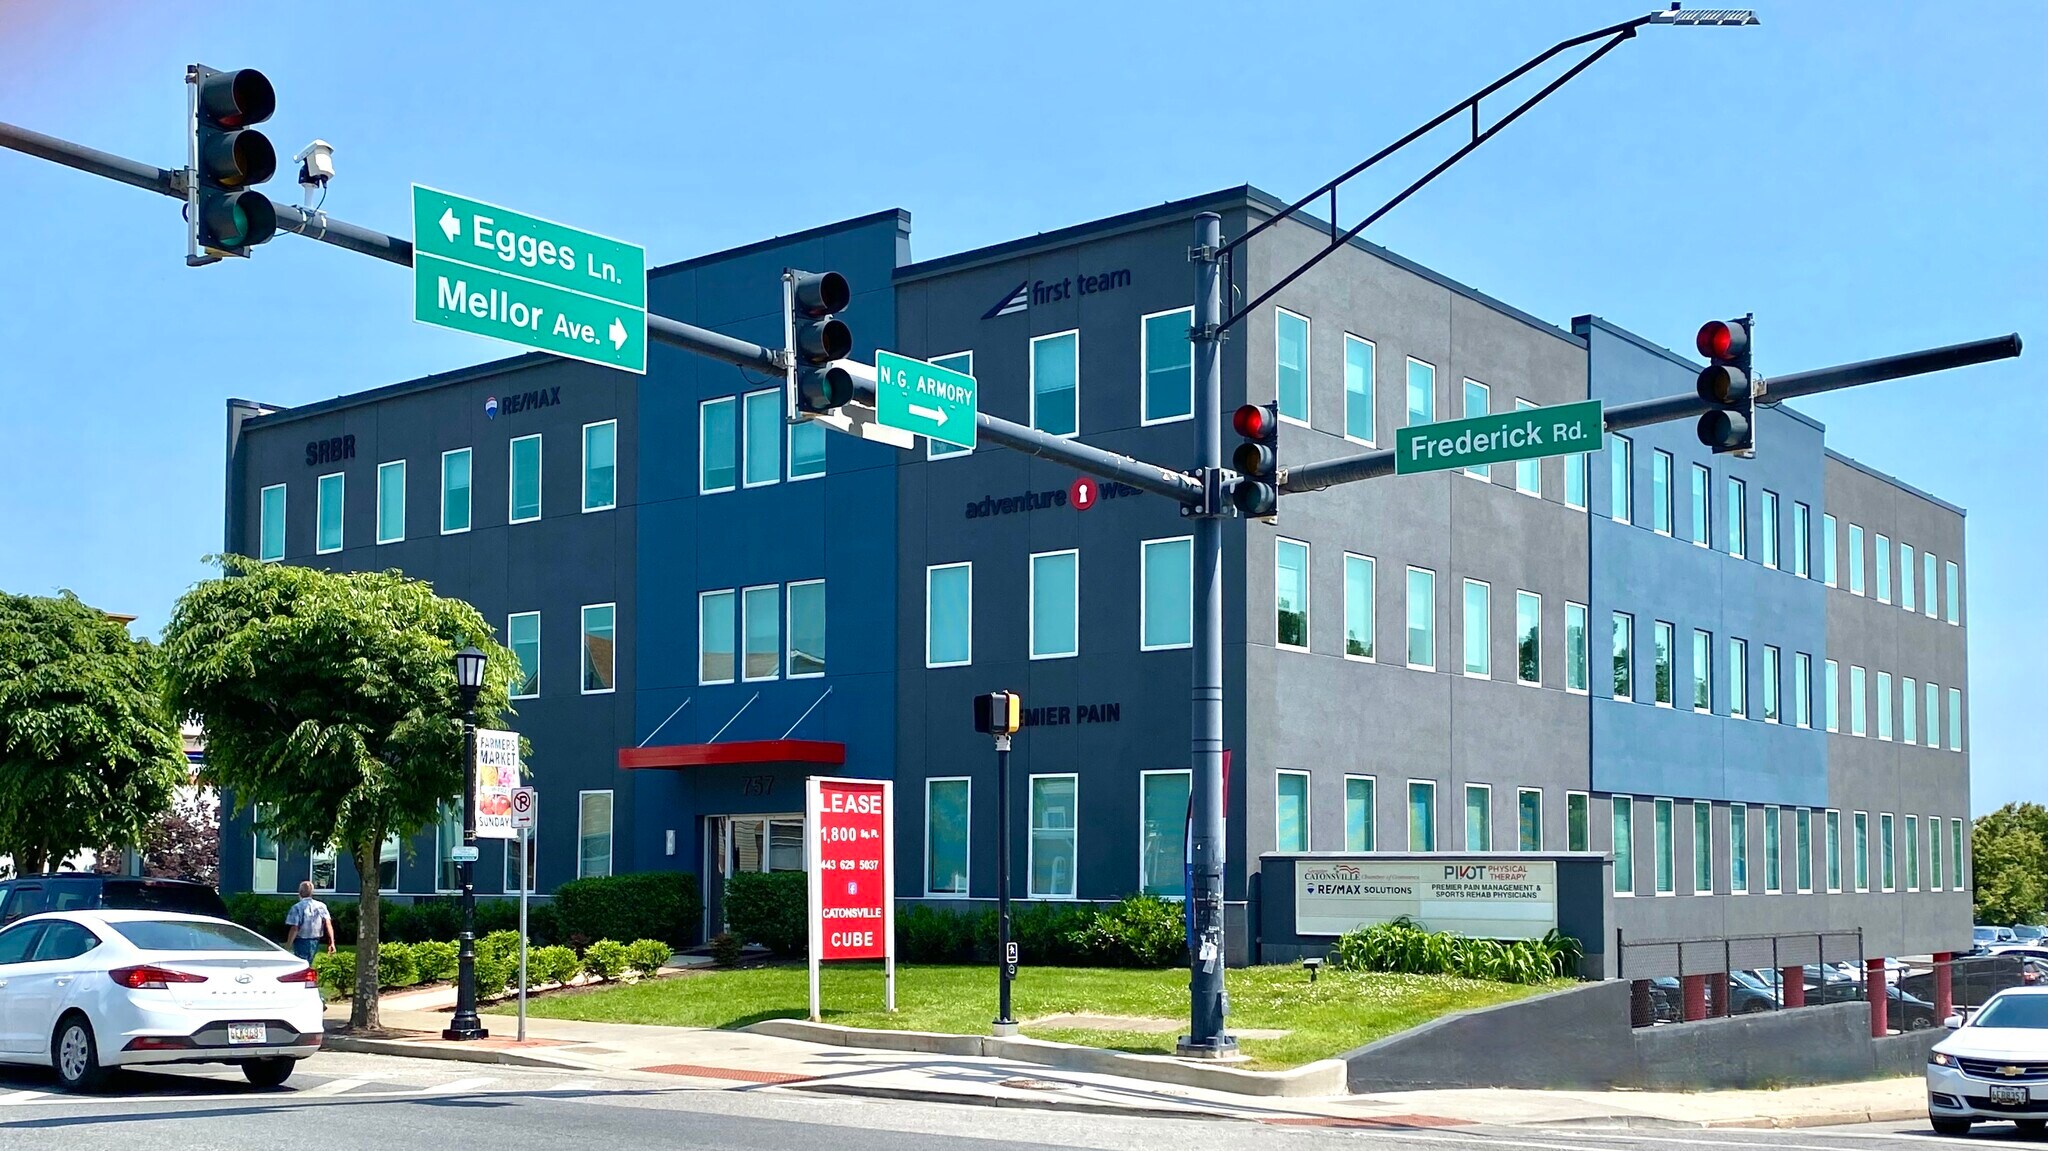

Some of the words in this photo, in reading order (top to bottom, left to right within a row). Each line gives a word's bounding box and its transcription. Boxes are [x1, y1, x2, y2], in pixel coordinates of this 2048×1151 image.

[472, 214, 576, 271] Egges
[587, 252, 622, 285] Ln.
[1032, 277, 1071, 305] first
[1077, 268, 1131, 296] team
[437, 276, 543, 331] Mellor
[552, 313, 601, 345] Ave.
[916, 375, 973, 406] ARMORY
[501, 386, 561, 416] RE/MAX
[305, 434, 355, 466] SRBR
[1411, 421, 1543, 461] Frederick
[1553, 421, 1588, 442] Rd.
[965, 488, 1067, 520] adventure
[1020, 706, 1070, 727] MIER
[1076, 702, 1120, 724] PAIN
[480, 736, 516, 751] FARMERS
[480, 749, 516, 766] MARKET
[742, 775, 775, 796] 757
[820, 792, 882, 814] LEASE
[820, 826, 857, 844] 1,800
[1444, 865, 1487, 880] PIVOT
[1488, 865, 1528, 873] PHYSICAL
[1490, 873, 1527, 881] THERAPY
[1317, 884, 1361, 895] RE/MAX
[1364, 886, 1413, 895] SOLUTIONS
[1431, 883, 1462, 891] PREMIER
[1481, 884, 1533, 892] MANAGEMENT
[1466, 891, 1492, 899] REHAB
[1493, 891, 1538, 899] PHYSICIANS
[822, 907, 882, 919] CATONSVILLE
[831, 931, 874, 947] CUBE
